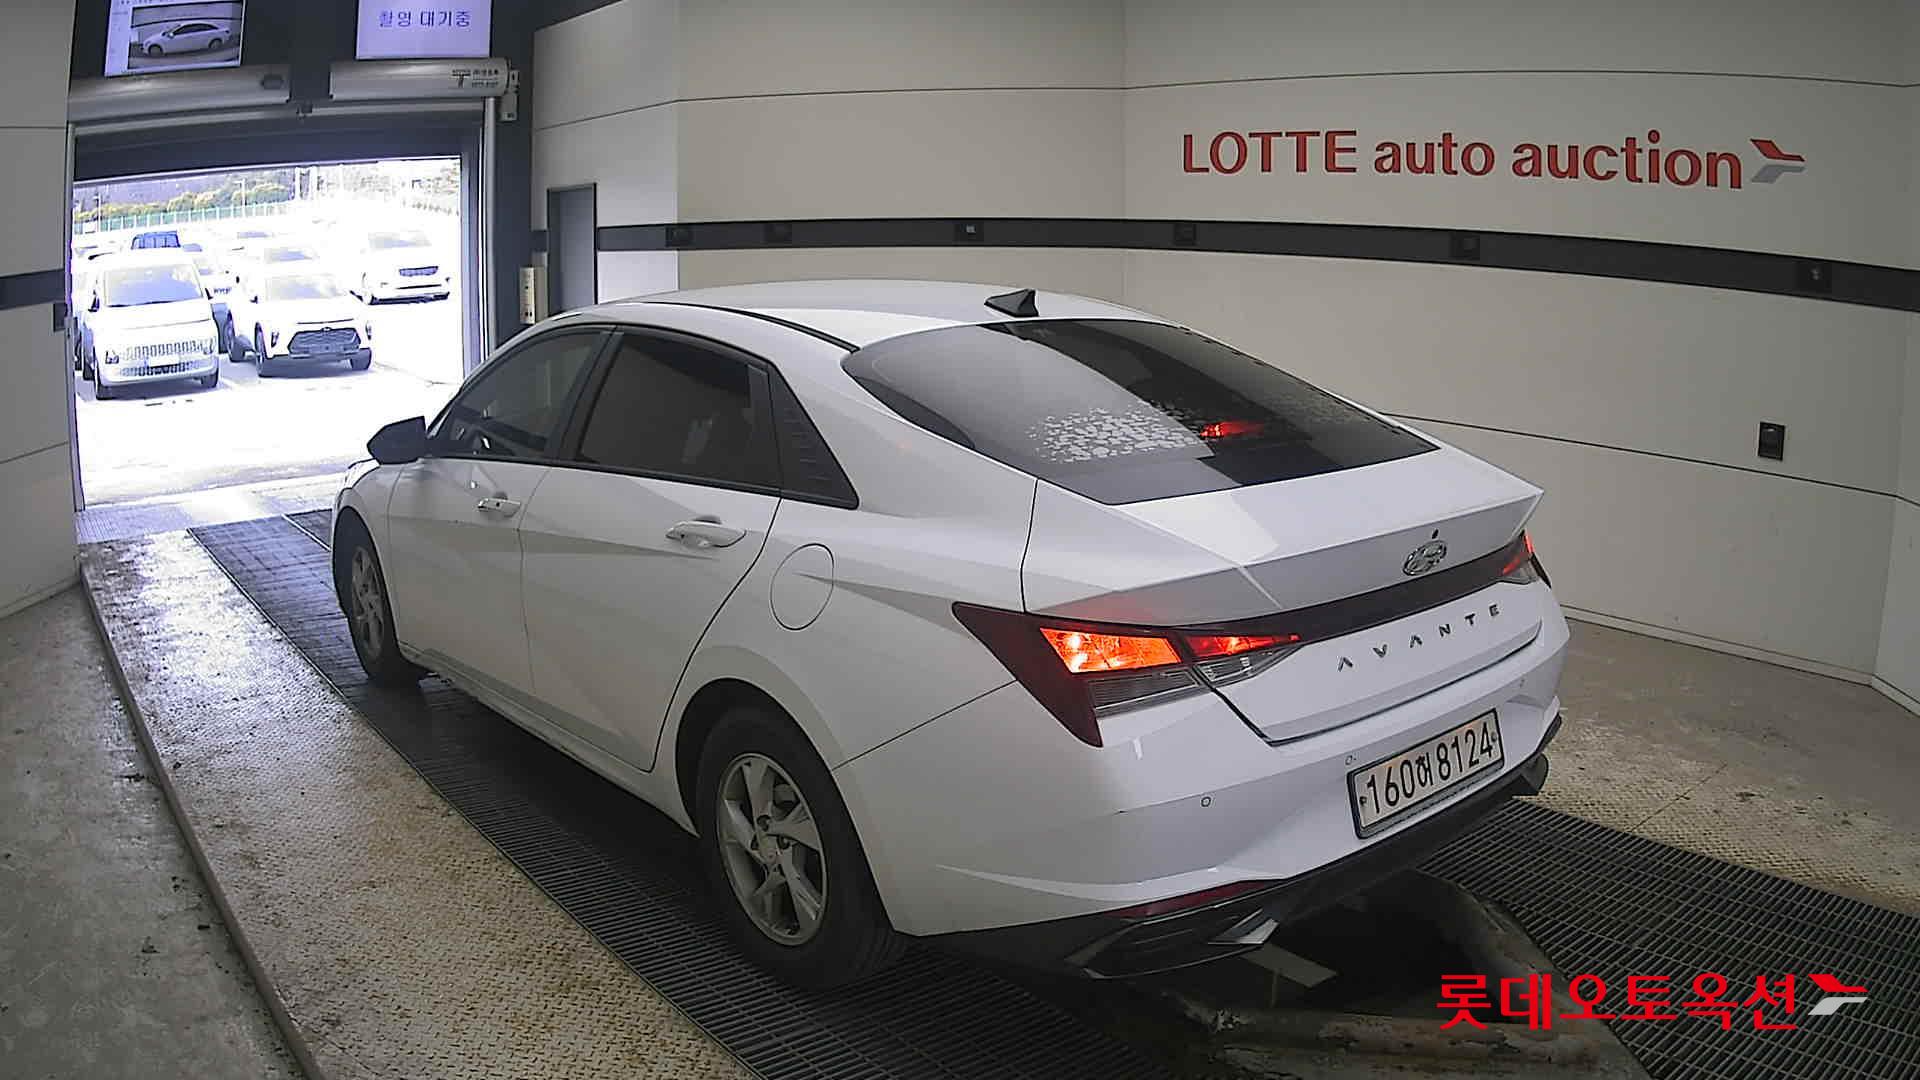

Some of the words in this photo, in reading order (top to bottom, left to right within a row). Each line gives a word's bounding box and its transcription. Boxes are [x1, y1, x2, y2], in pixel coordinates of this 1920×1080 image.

[420, 10, 470, 27] 대기중
[1183, 130, 1357, 174] LOTTE
[1374, 132, 1496, 176] auto
[1511, 129, 1742, 189] auction
[1337, 604, 1500, 672] AVANTE
